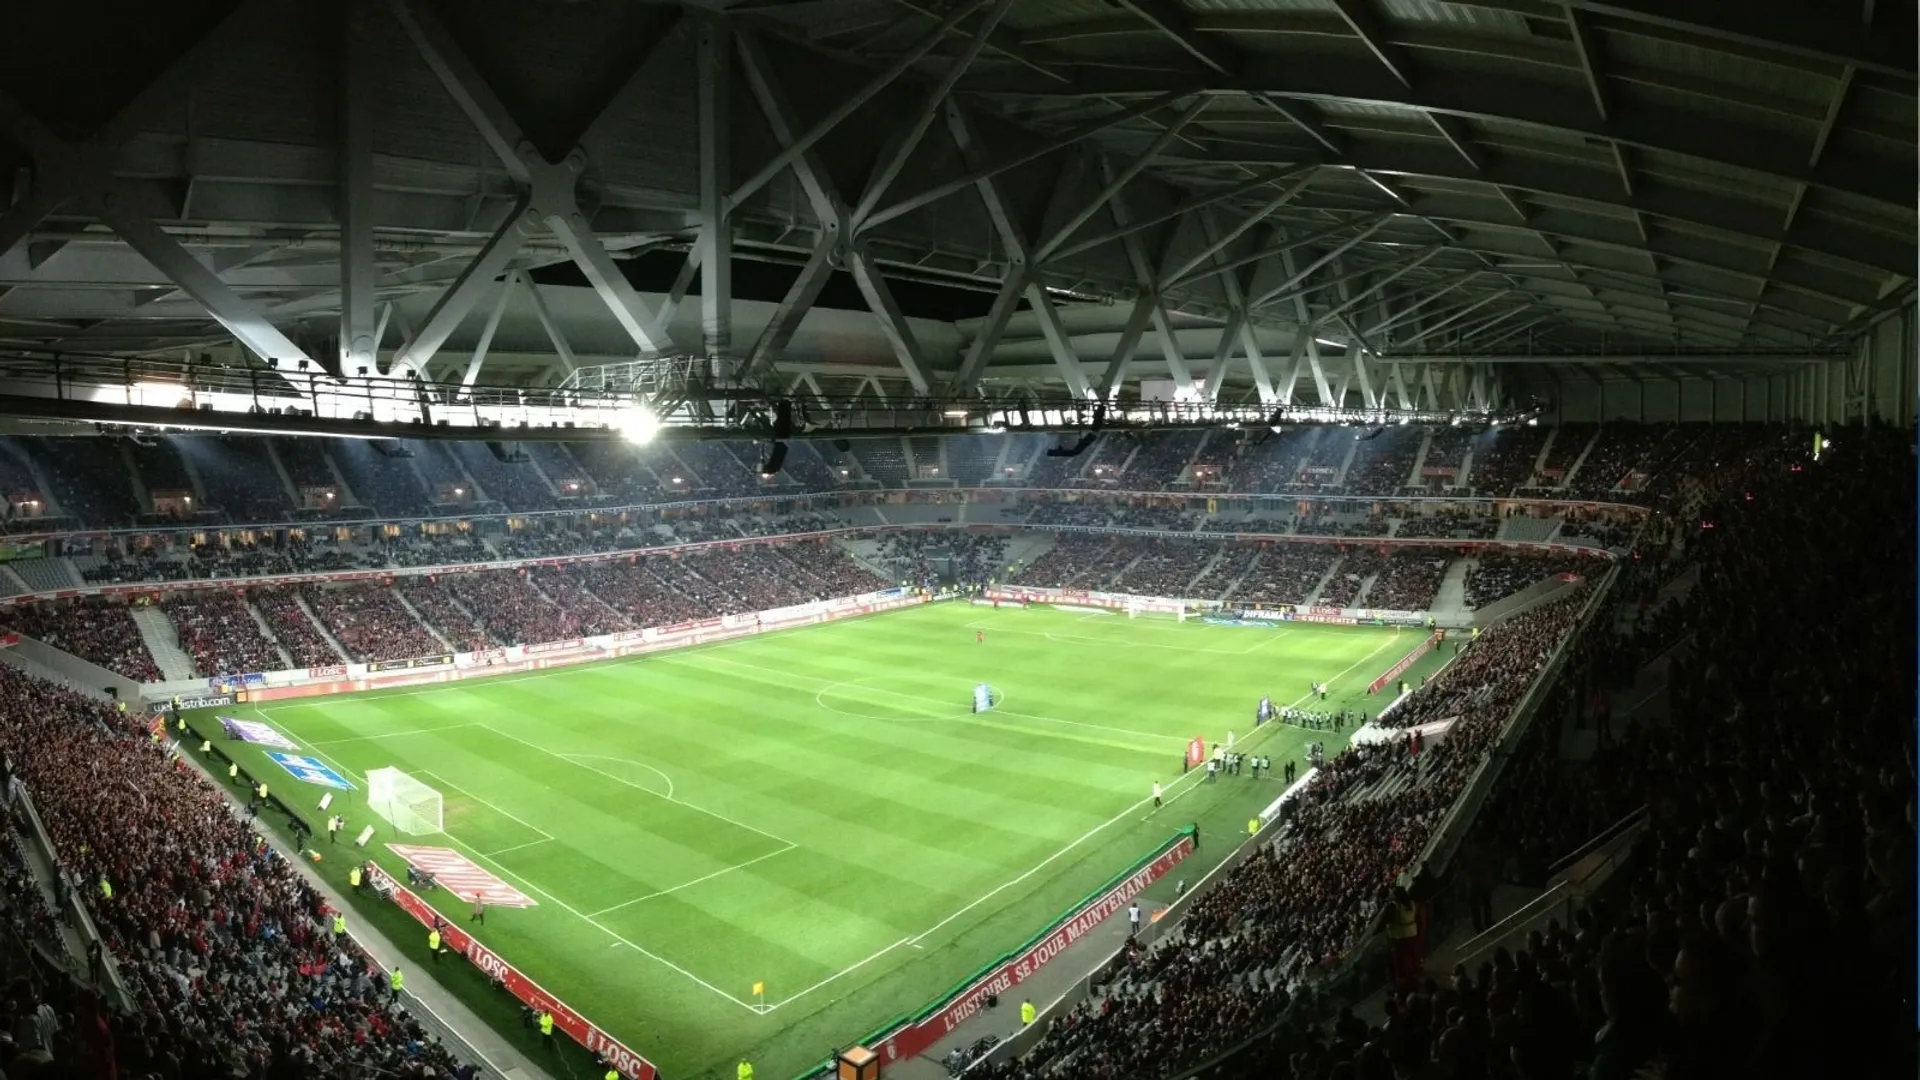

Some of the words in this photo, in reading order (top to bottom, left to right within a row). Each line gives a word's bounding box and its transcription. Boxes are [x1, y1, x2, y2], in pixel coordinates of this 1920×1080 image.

[475, 947, 509, 983] LOSC
[943, 971, 1012, 1031] L'HISTOIRE
[1015, 960, 1033, 983] SE
[1032, 935, 1067, 970] JOUE
[1067, 866, 1154, 943] MAINTENANT
[598, 1037, 642, 1079] LOSC
